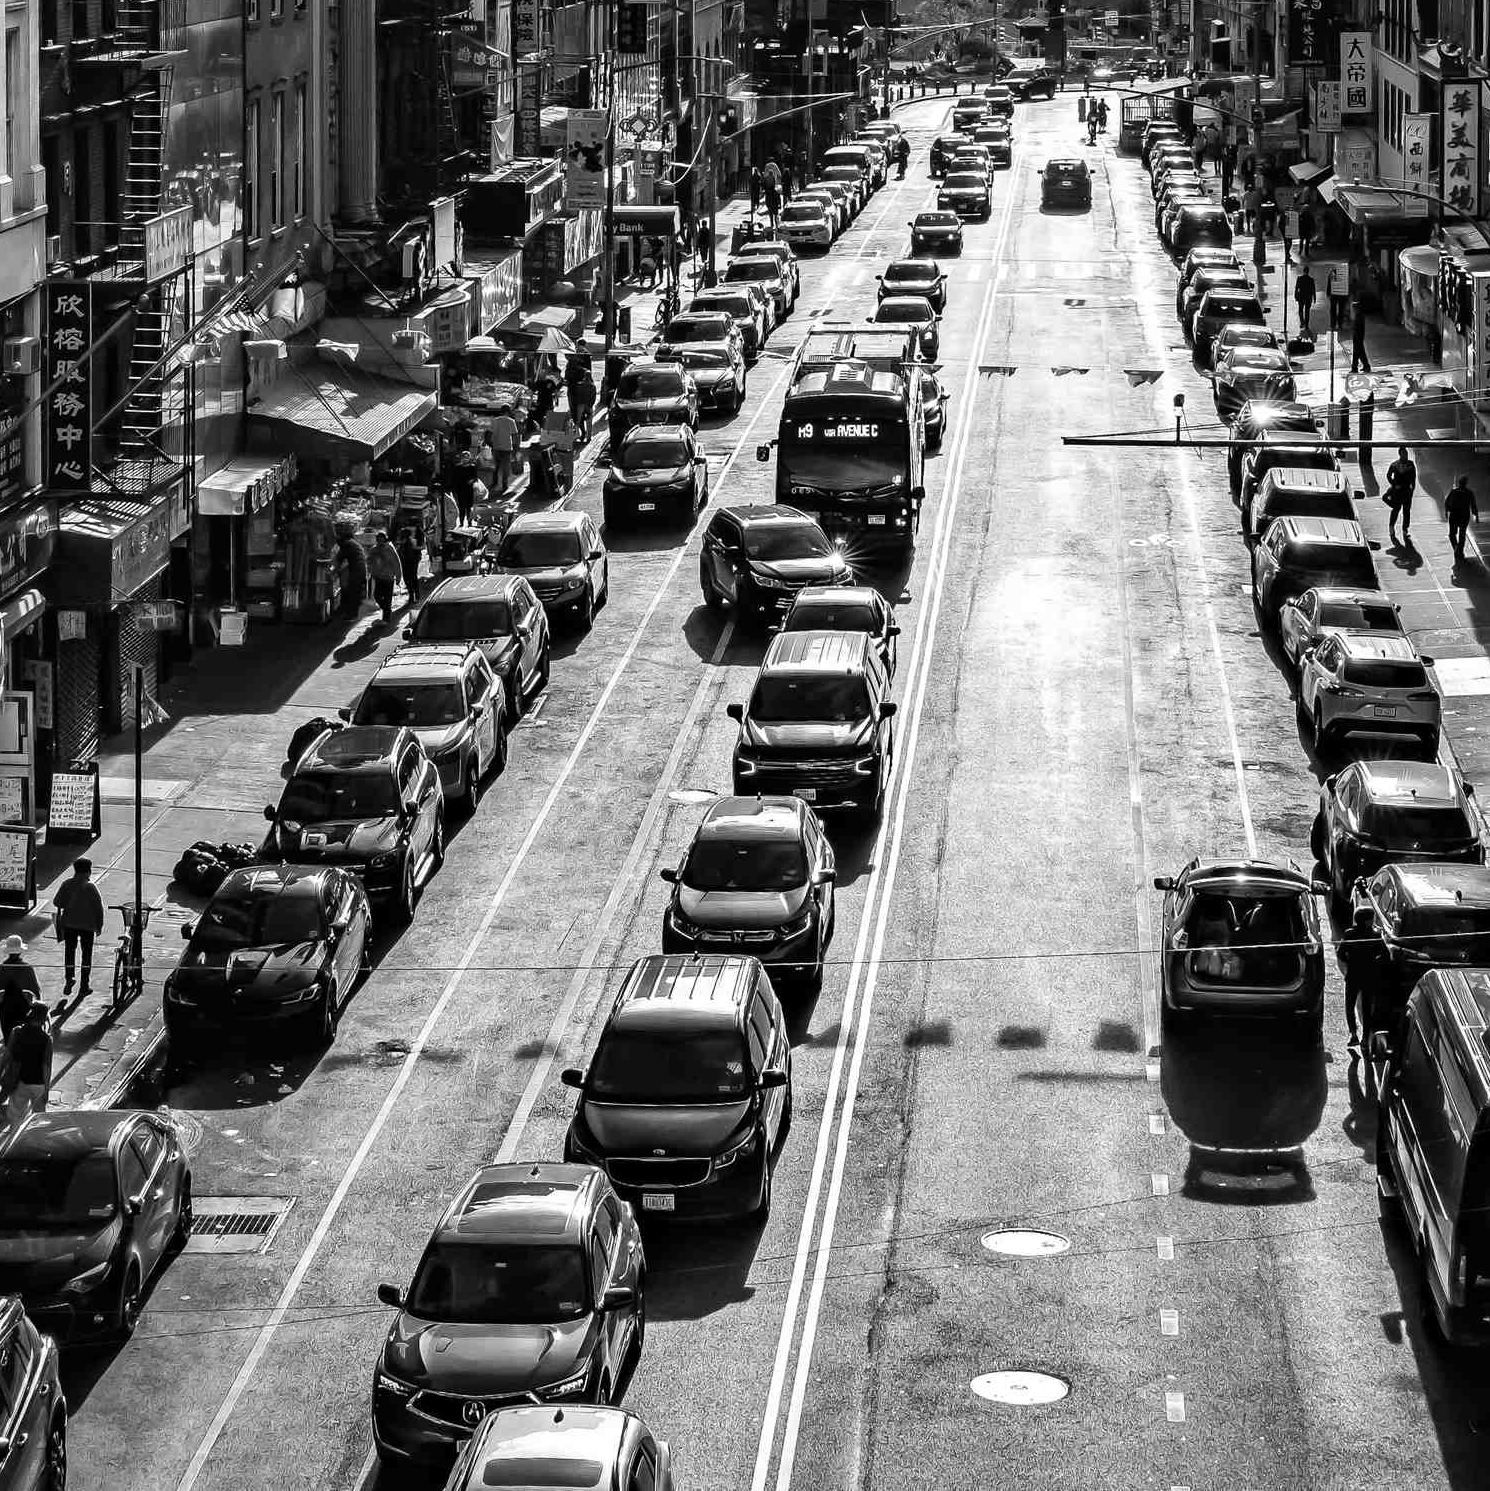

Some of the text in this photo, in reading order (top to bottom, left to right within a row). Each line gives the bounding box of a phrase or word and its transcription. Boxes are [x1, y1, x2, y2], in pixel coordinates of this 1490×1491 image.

[1347, 38, 1366, 108] 大帝國
[619, 222, 644, 233] Bank
[53, 294, 86, 481] 欣榕服務中心
[798, 423, 813, 438] M9
[871, 424, 878, 437] C
